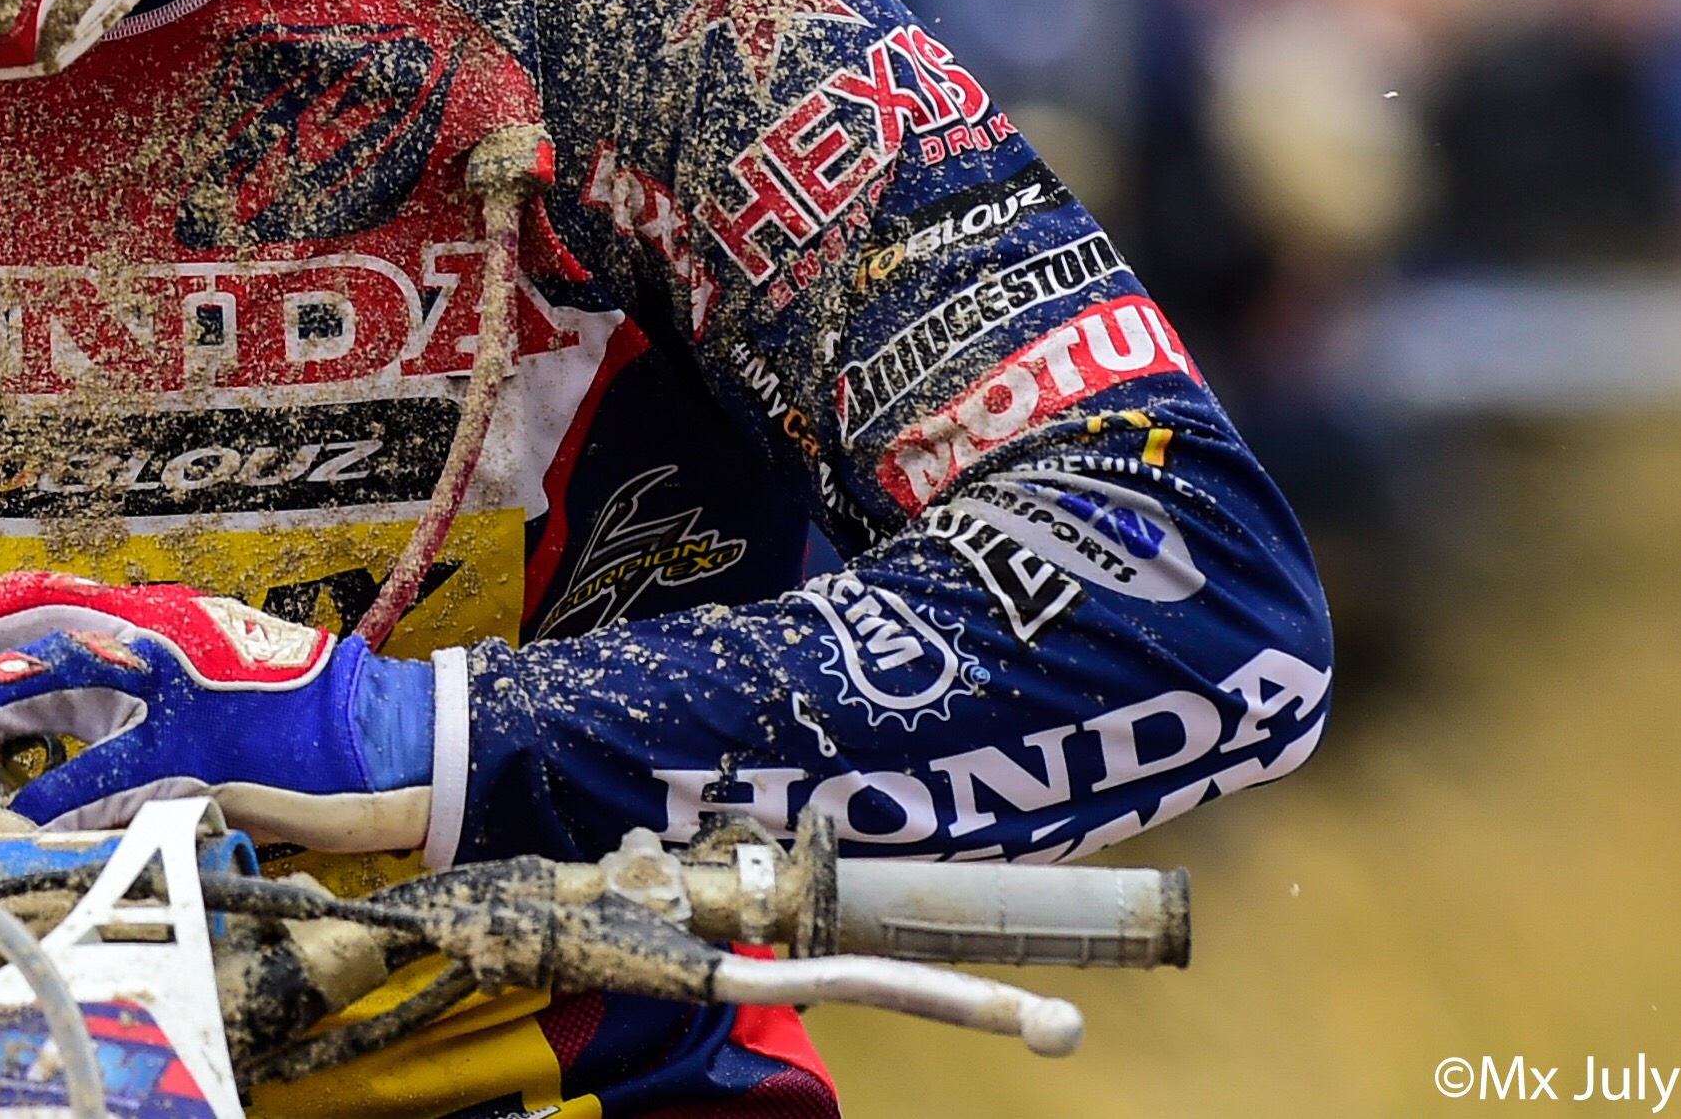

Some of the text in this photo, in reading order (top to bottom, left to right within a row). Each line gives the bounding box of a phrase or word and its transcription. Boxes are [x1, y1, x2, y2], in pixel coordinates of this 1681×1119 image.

[693, 24, 992, 288] HEXIS
[665, 545, 740, 579] EXO
[652, 647, 1332, 845] HONDA
